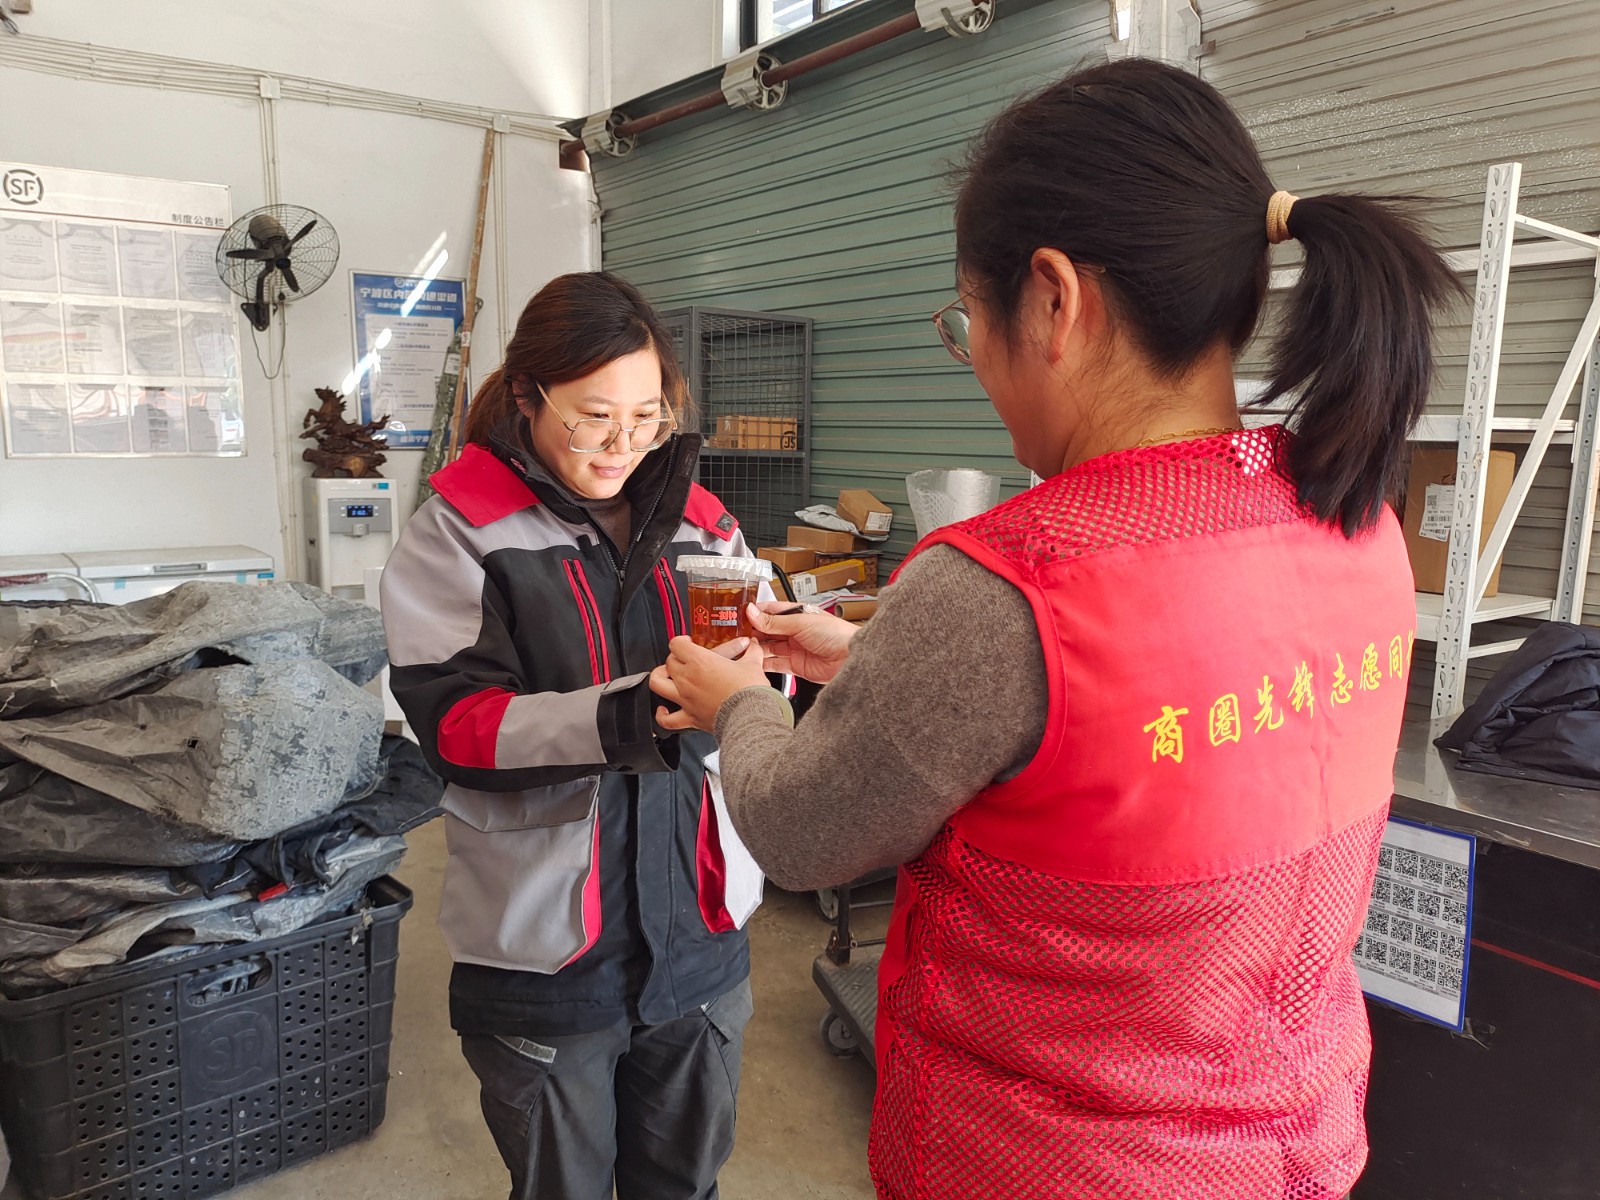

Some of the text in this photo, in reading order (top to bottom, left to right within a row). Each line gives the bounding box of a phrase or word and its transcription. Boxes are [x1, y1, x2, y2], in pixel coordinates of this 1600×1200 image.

[10, 178, 36, 196] SF
[172, 213, 225, 227] 制度公告栏
